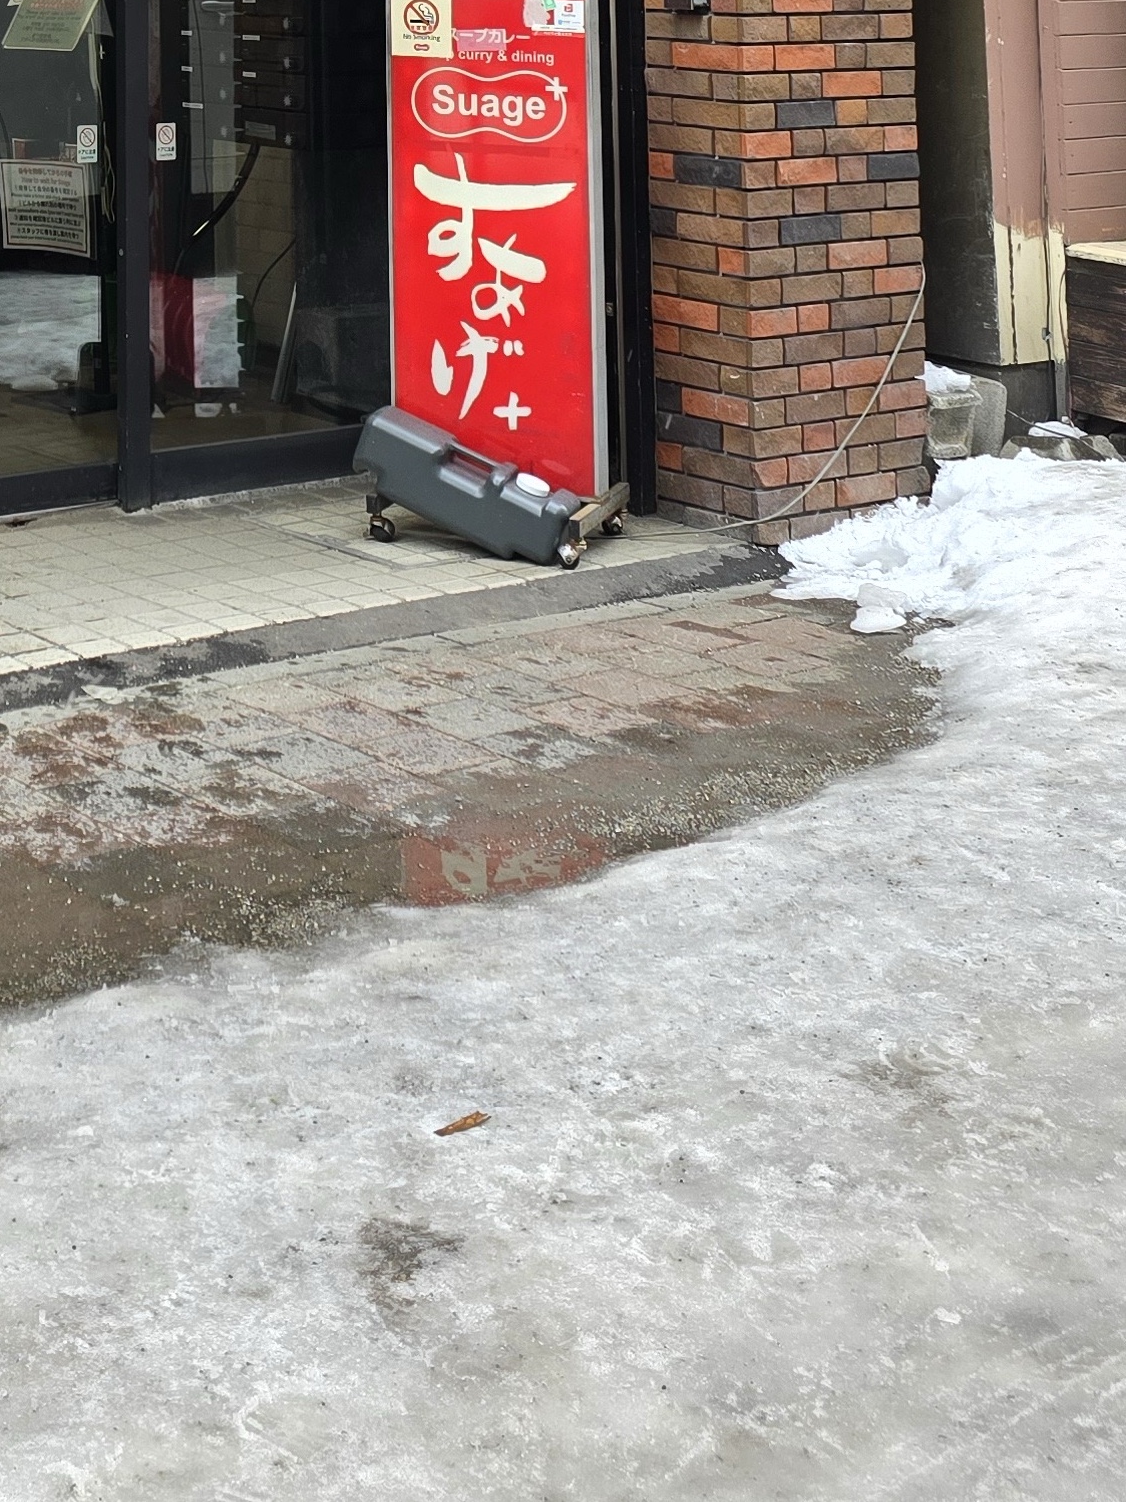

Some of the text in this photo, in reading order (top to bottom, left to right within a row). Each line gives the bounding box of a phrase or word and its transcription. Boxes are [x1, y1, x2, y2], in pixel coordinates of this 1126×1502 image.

[458, 50, 493, 64] curry
[497, 50, 507, 62] &
[511, 50, 555, 66] dining
